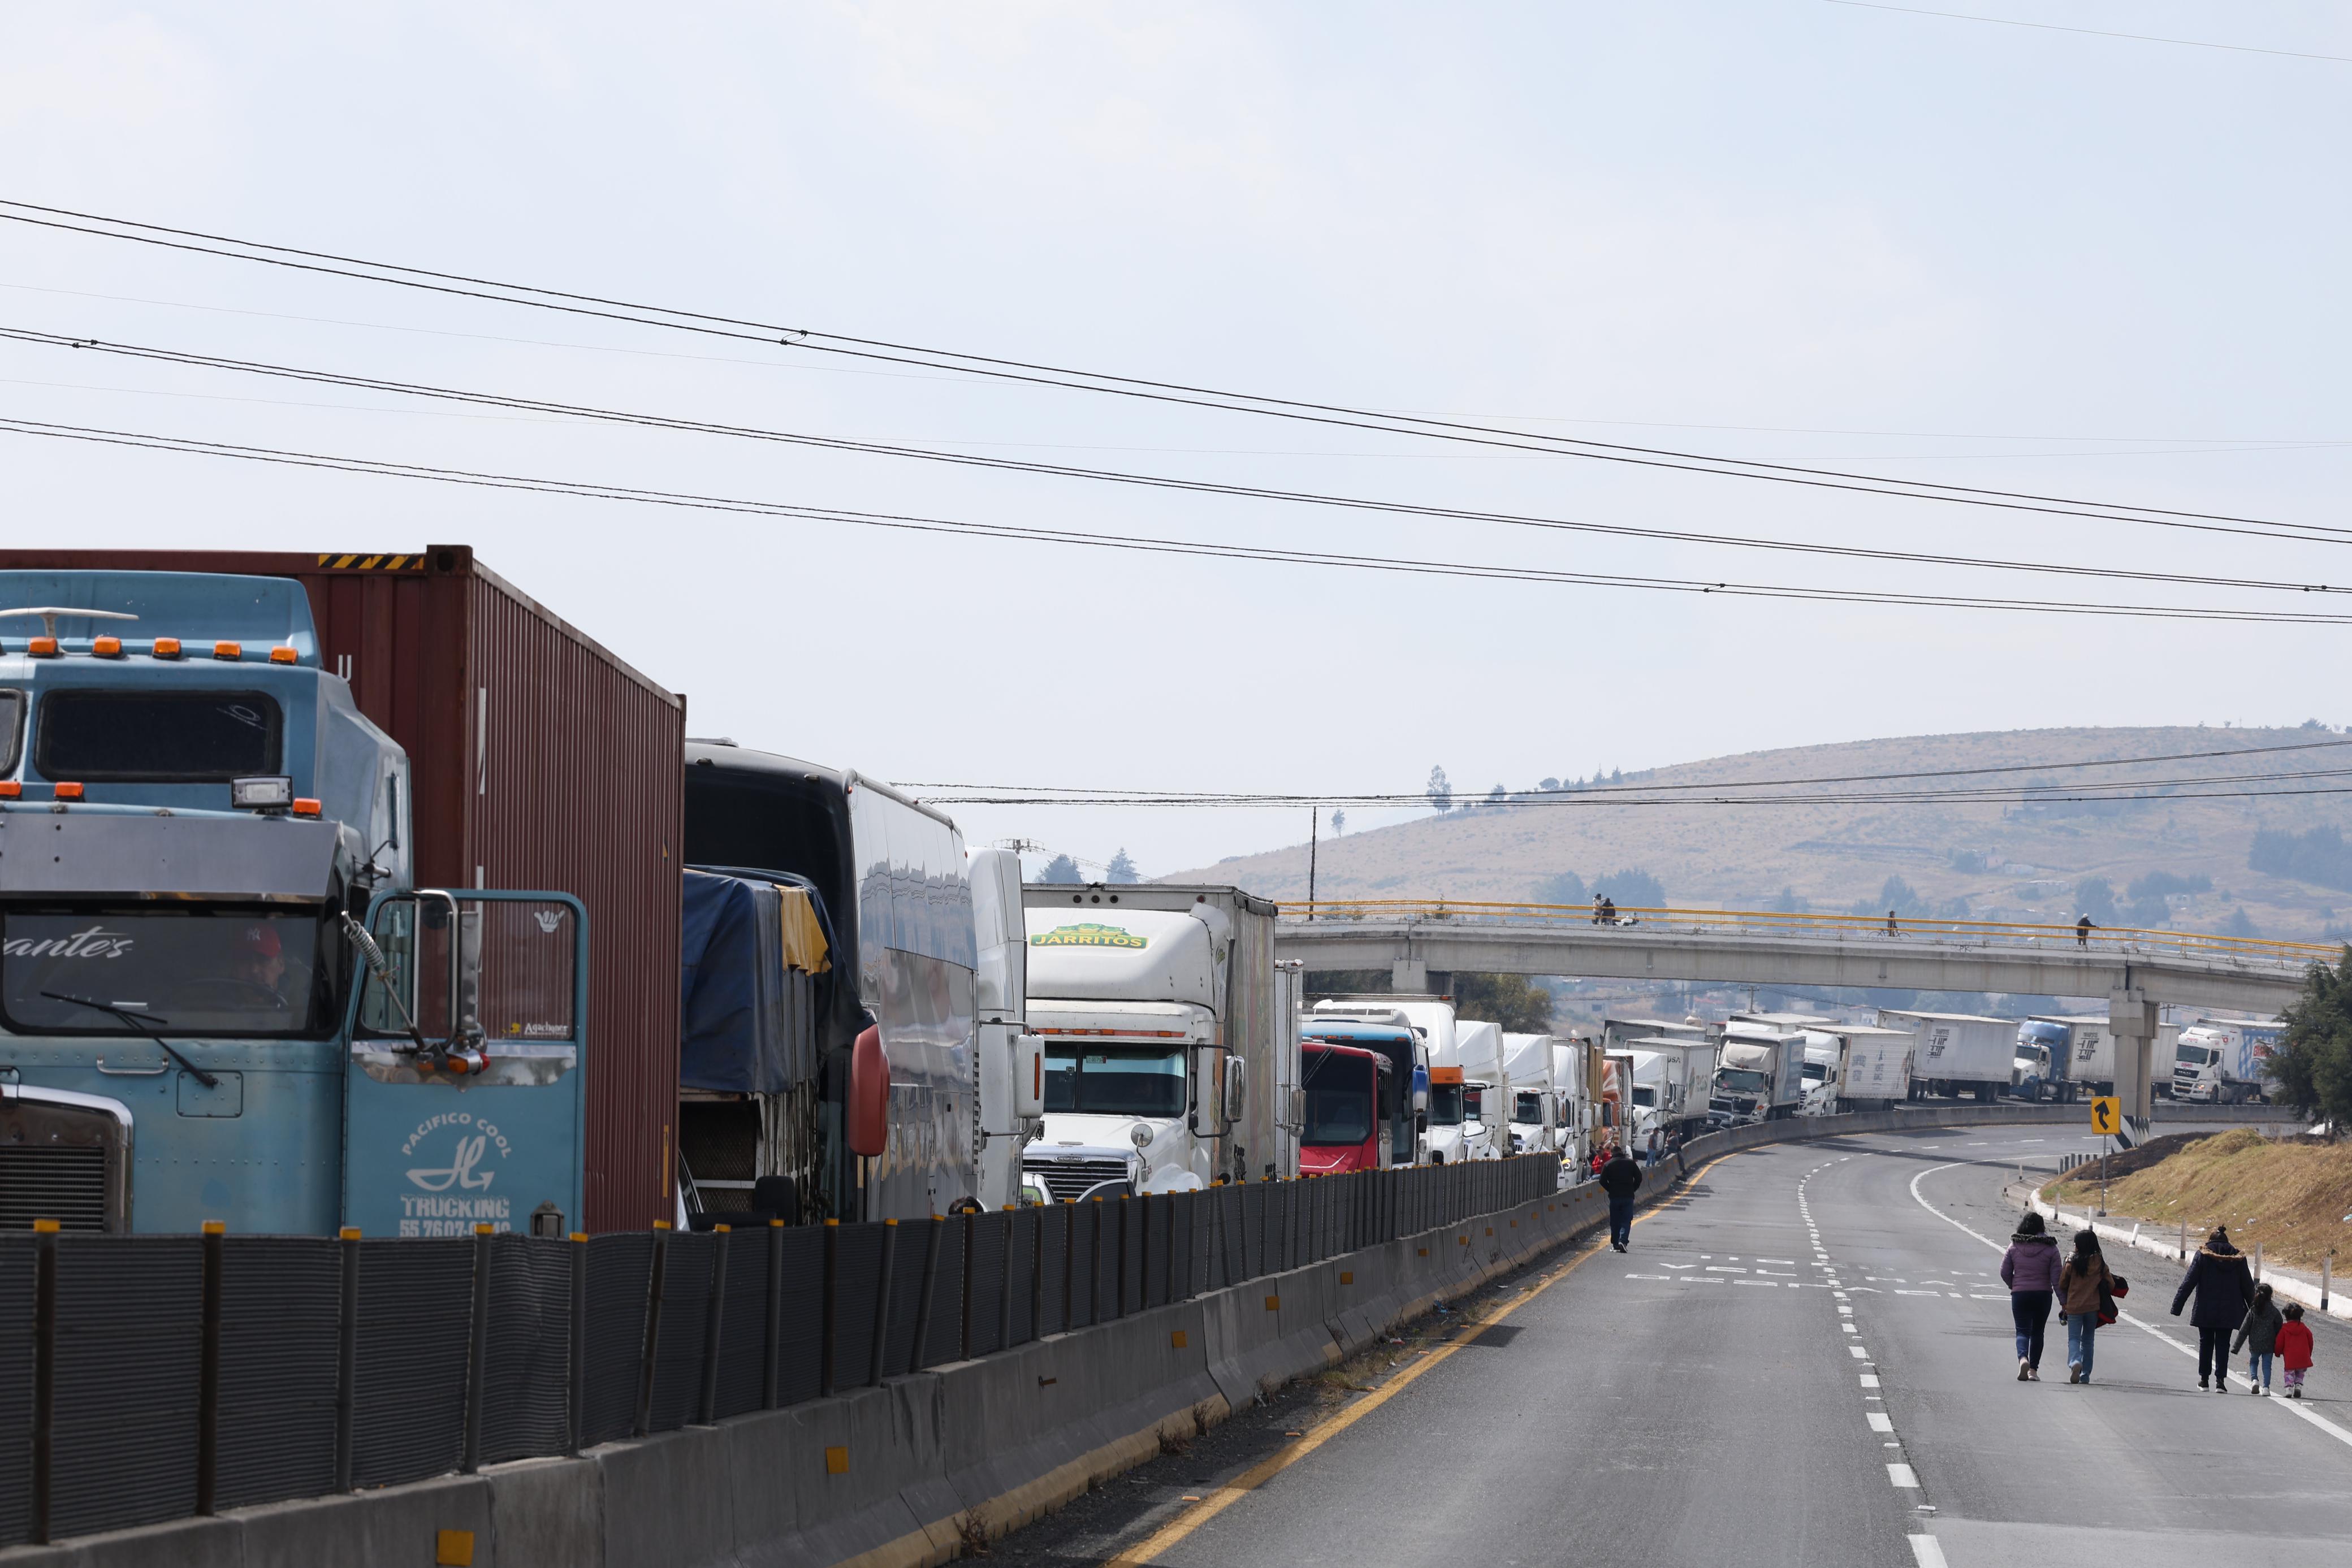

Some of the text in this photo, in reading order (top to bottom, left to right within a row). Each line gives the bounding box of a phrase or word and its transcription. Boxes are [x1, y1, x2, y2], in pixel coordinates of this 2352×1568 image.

[1035, 935, 1142, 947] JARRITOS
[402, 1112, 512, 1158] PACIFICO COOL
[400, 1194, 510, 1218] TRUCKING
[399, 1219, 420, 1237] 55
